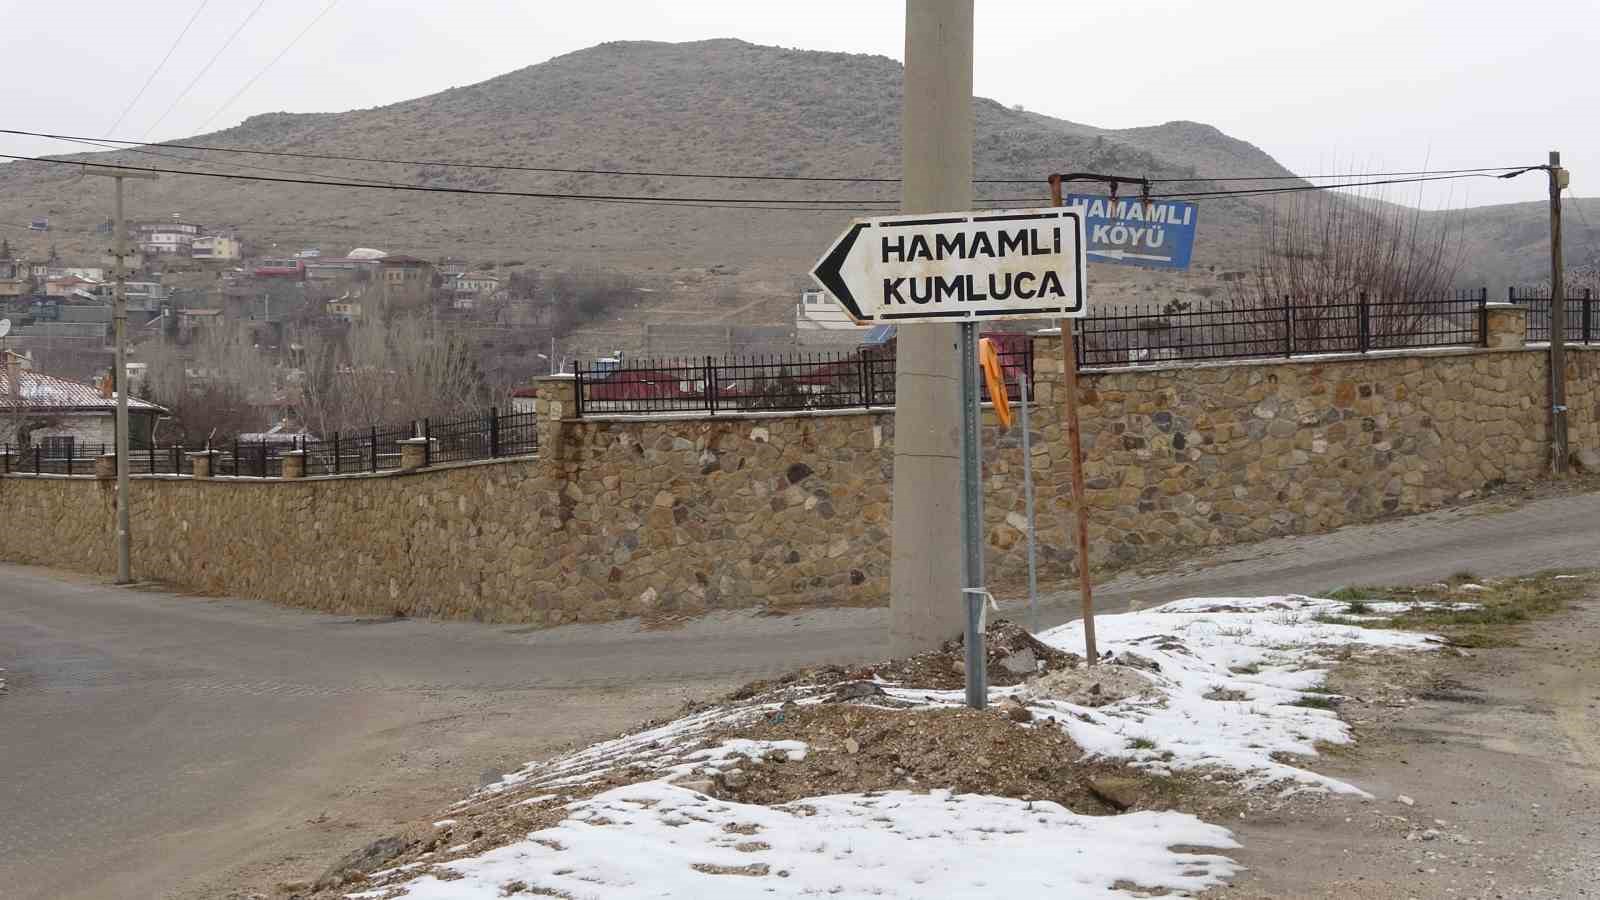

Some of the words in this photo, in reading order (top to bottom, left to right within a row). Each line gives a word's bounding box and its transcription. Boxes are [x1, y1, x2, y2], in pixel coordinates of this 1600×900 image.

[1072, 198, 1192, 225] HAMAMLI
[881, 227, 1061, 263] HAMAMLI
[1092, 221, 1165, 248] KÖYÜ
[883, 270, 1066, 305] KUMLUCA
